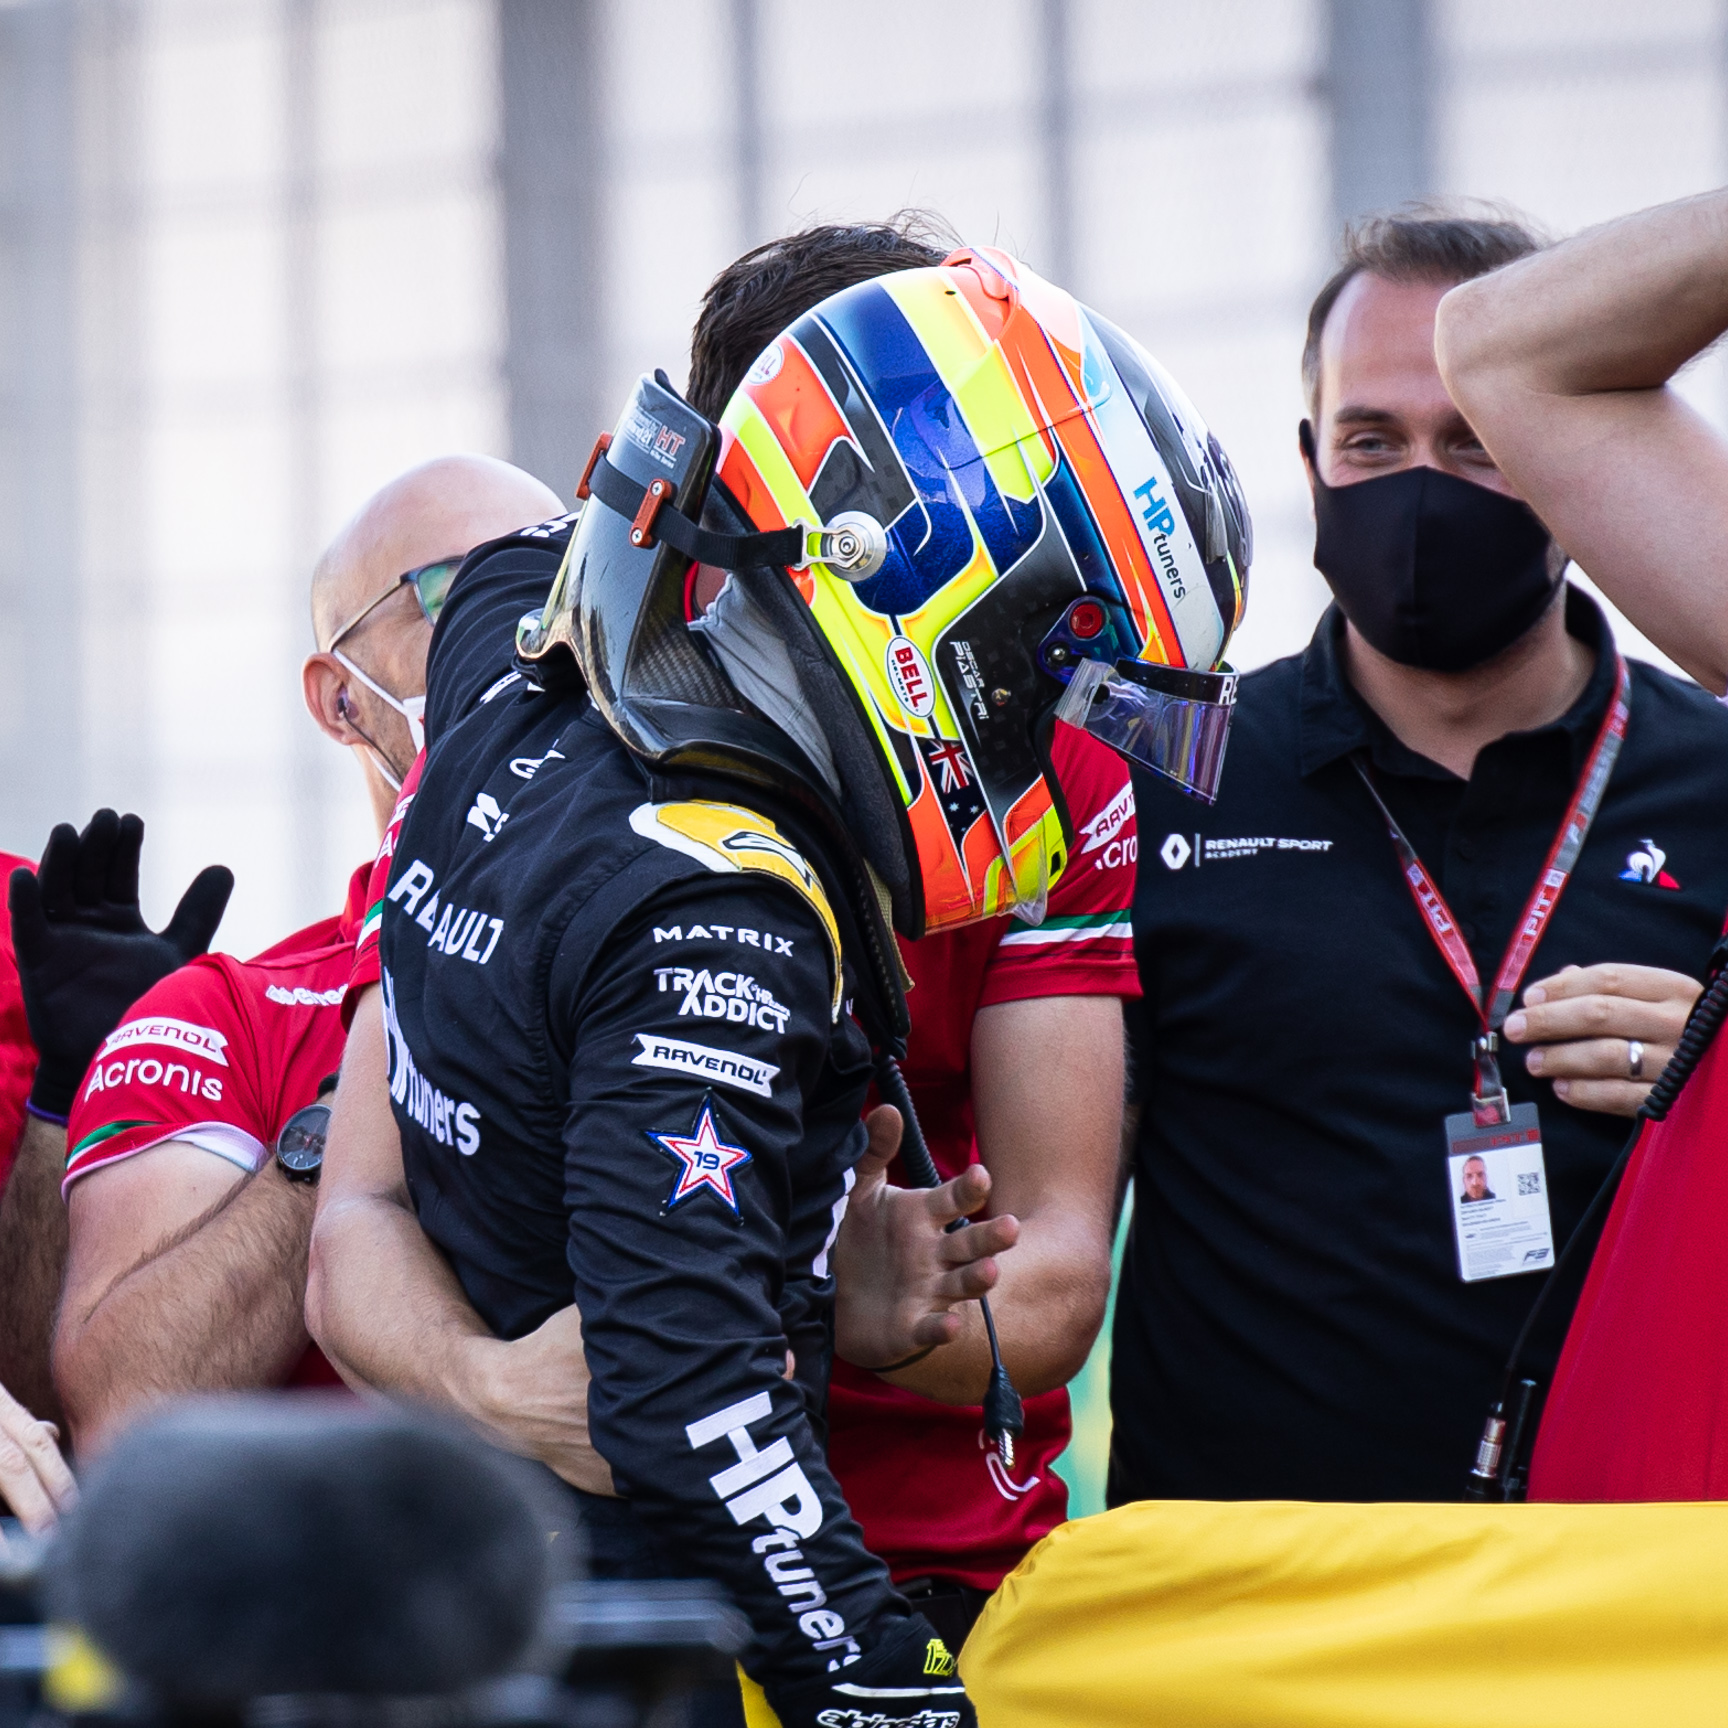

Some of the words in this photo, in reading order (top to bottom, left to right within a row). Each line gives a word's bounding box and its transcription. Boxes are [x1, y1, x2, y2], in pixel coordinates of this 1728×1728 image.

[655, 425, 687, 456] HT
[894, 646, 928, 708] BELL
[961, 640, 986, 688] OSCAR
[1205, 837, 1276, 850] RENAULT
[1277, 838, 1334, 851] SPORT
[653, 925, 795, 957] MATRIX
[653, 967, 756, 1000] TRACK
[678, 994, 791, 1034] ADDICT
[84, 1058, 224, 1104] Acronis
[652, 1045, 768, 1086] RAVENOL
[693, 1151, 721, 1171] 19
